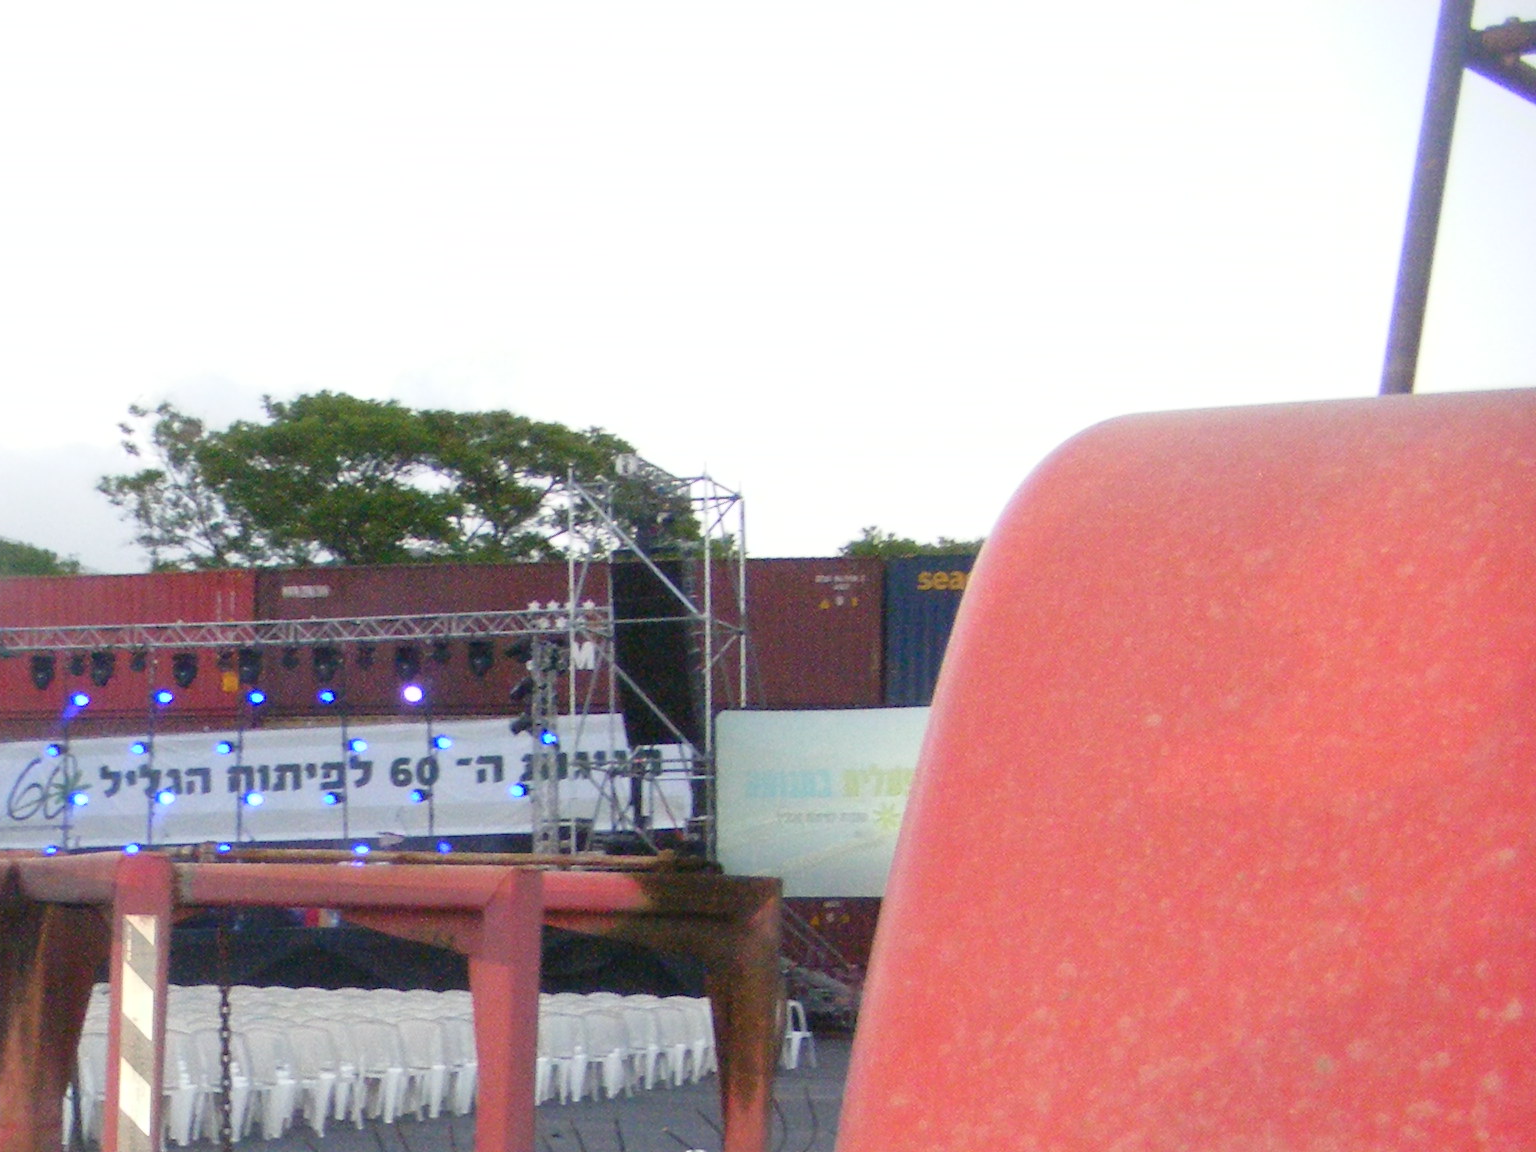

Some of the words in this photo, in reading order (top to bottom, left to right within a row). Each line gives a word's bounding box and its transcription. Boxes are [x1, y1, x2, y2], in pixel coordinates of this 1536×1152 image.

[917, 571, 970, 591] sea
[99, 762, 212, 798] הגליל
[226, 754, 373, 793] לפיתוח
[390, 756, 440, 788] 60
